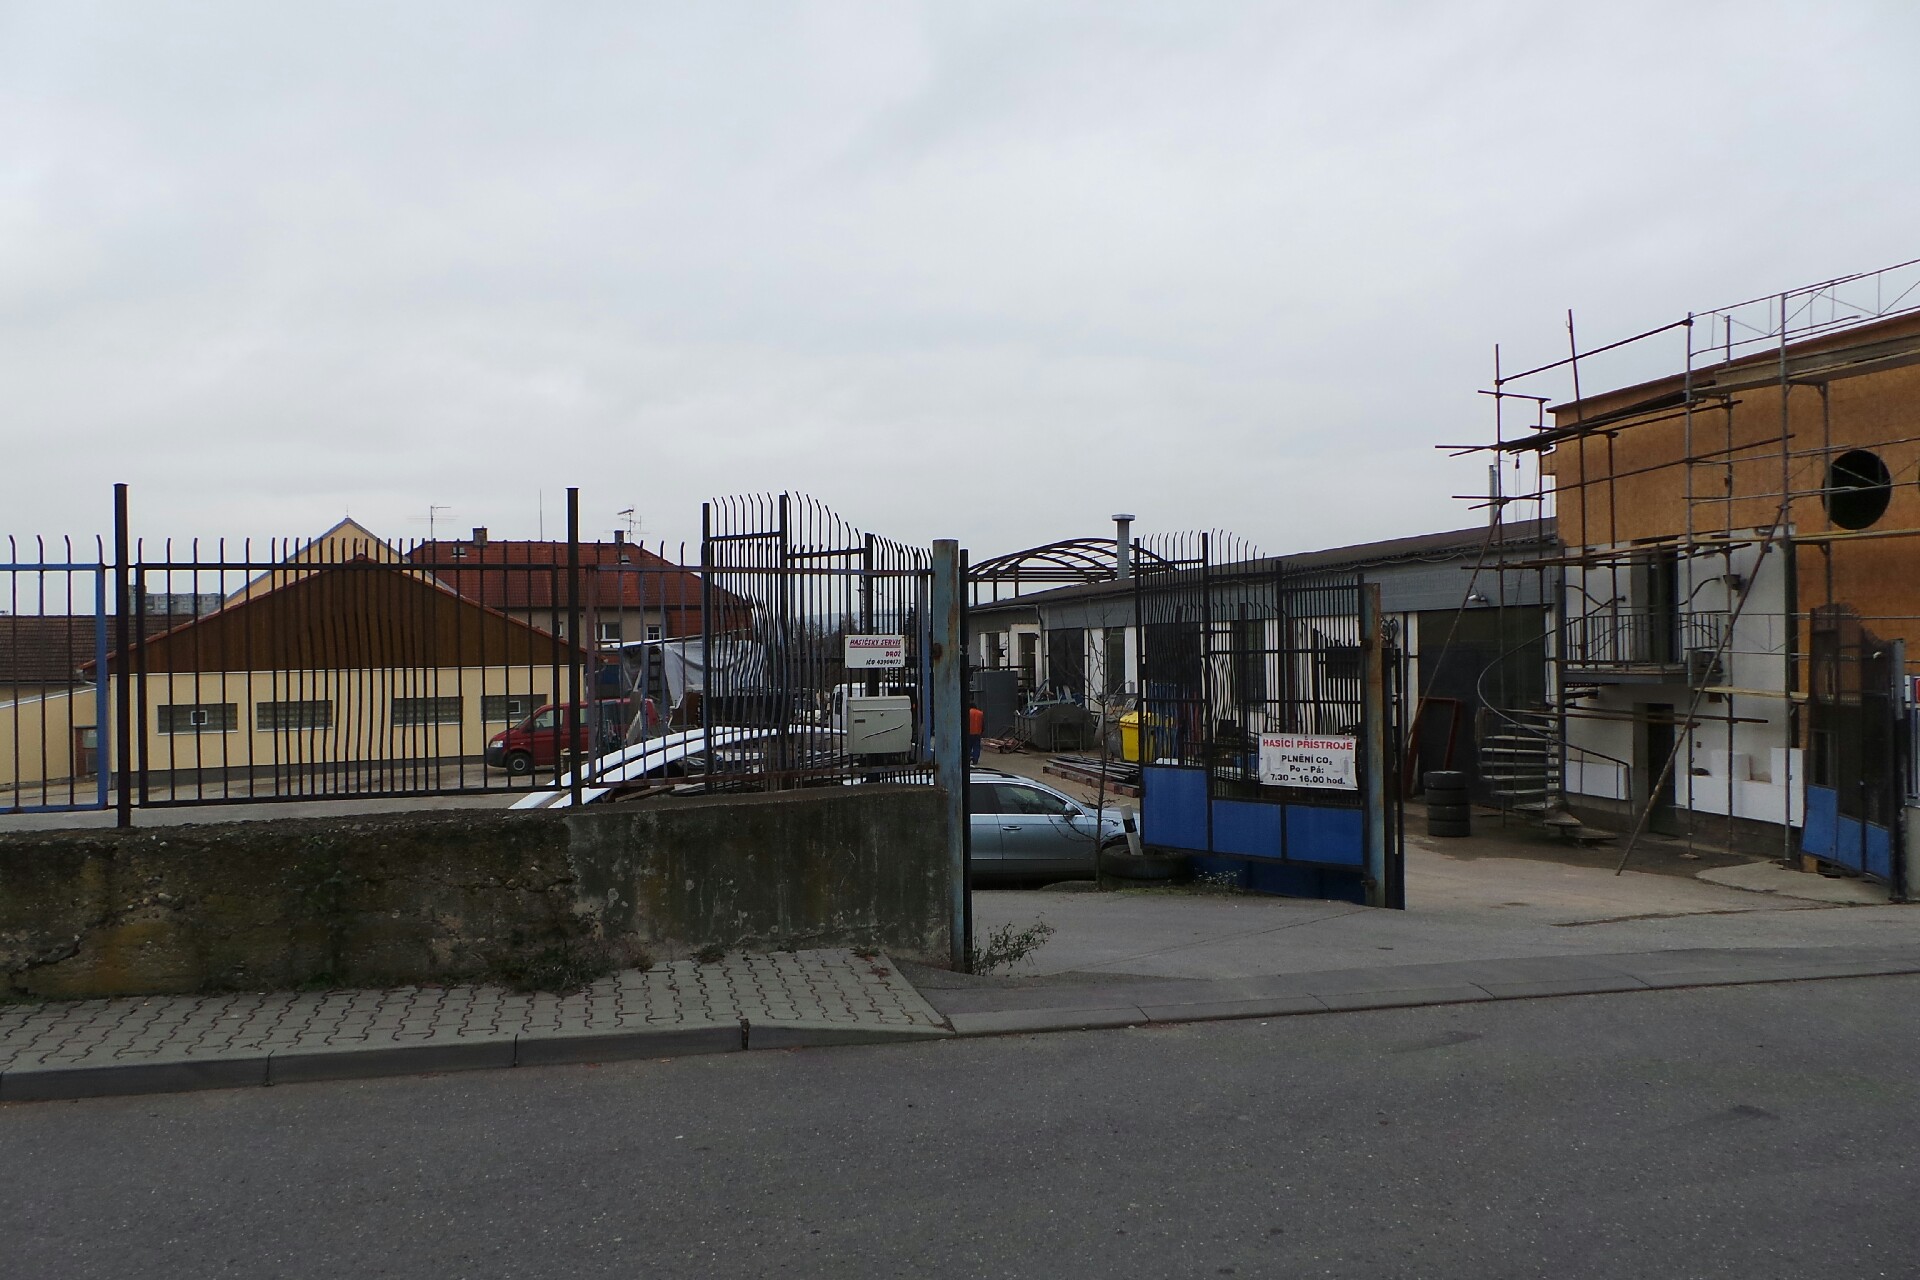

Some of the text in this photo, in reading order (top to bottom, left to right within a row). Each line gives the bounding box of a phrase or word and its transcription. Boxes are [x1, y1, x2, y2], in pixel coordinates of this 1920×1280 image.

[1262, 737, 1354, 750] HASÍCÍ PŘÍSTROJE
[1282, 754, 1314, 764] PLNĚNÍ
[1290, 764, 1300, 772] Po
[1310, 765, 1324, 774] Pá:
[1270, 774, 1289, 782] 7.30
[1300, 775, 1324, 784] 16.00
[1326, 776, 1346, 785] hod.
